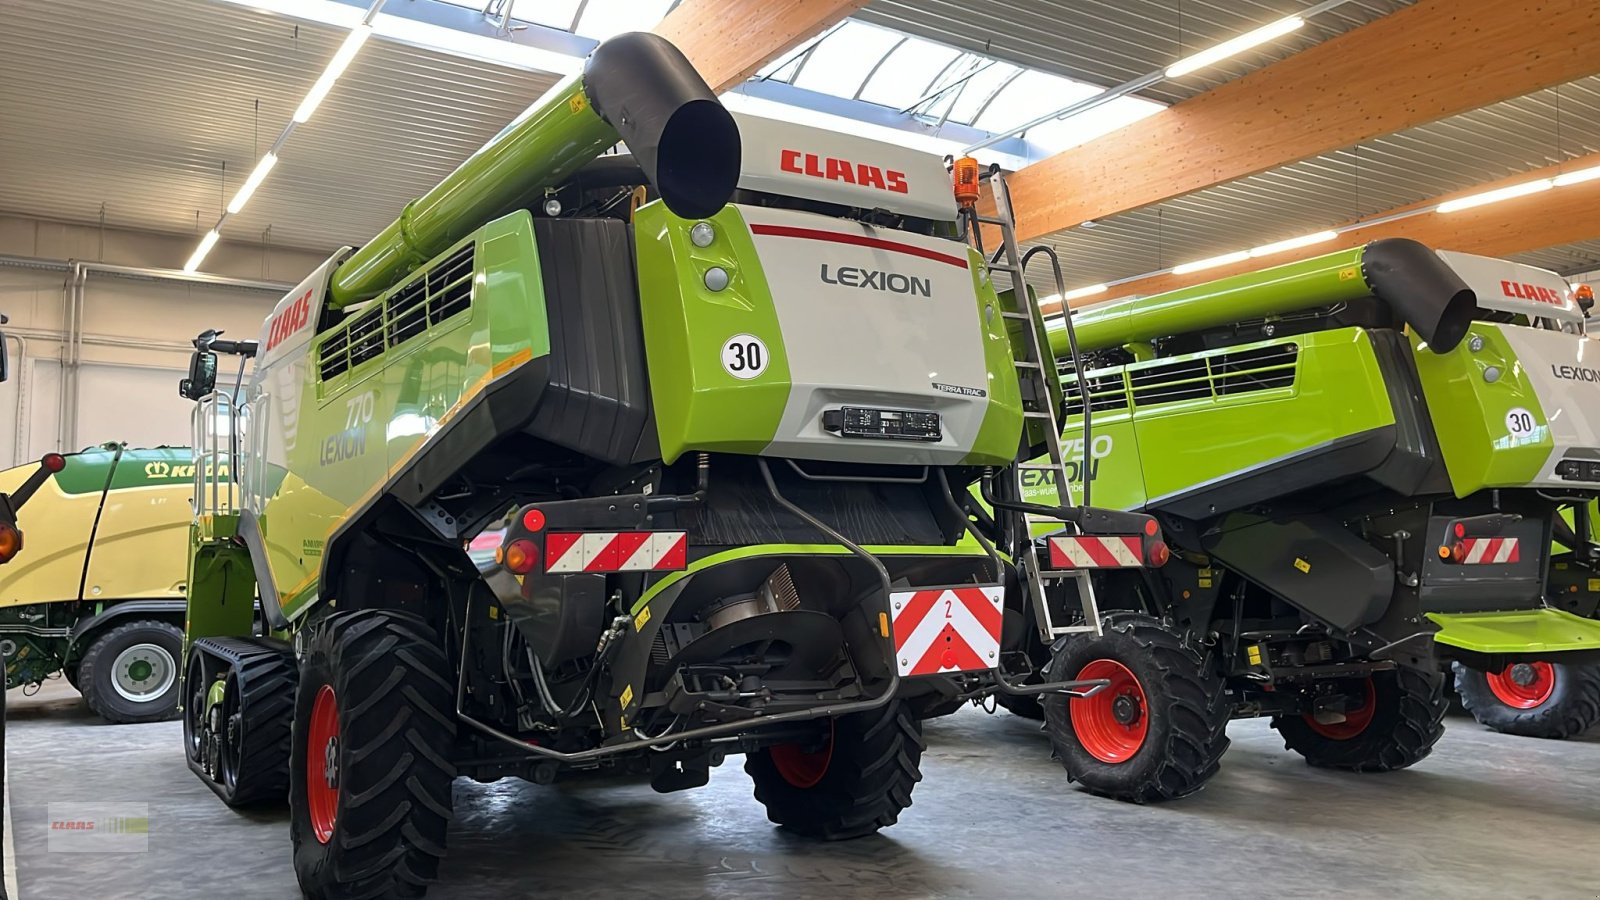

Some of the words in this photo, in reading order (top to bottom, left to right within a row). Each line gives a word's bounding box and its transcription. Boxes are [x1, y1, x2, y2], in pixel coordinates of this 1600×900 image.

[780, 149, 908, 194] CLAAS
[820, 263, 931, 298] LEXION
[1500, 280, 1563, 305] CLAAS
[266, 288, 314, 352] CLAAS
[728, 341, 761, 372] 30
[937, 384, 962, 394] TERRA
[963, 388, 982, 396] TRAC
[345, 391, 375, 430] 770
[1509, 413, 1532, 433] 30
[320, 427, 367, 467] LEXION
[1060, 434, 1113, 461] 750
[944, 600, 952, 619] 2
